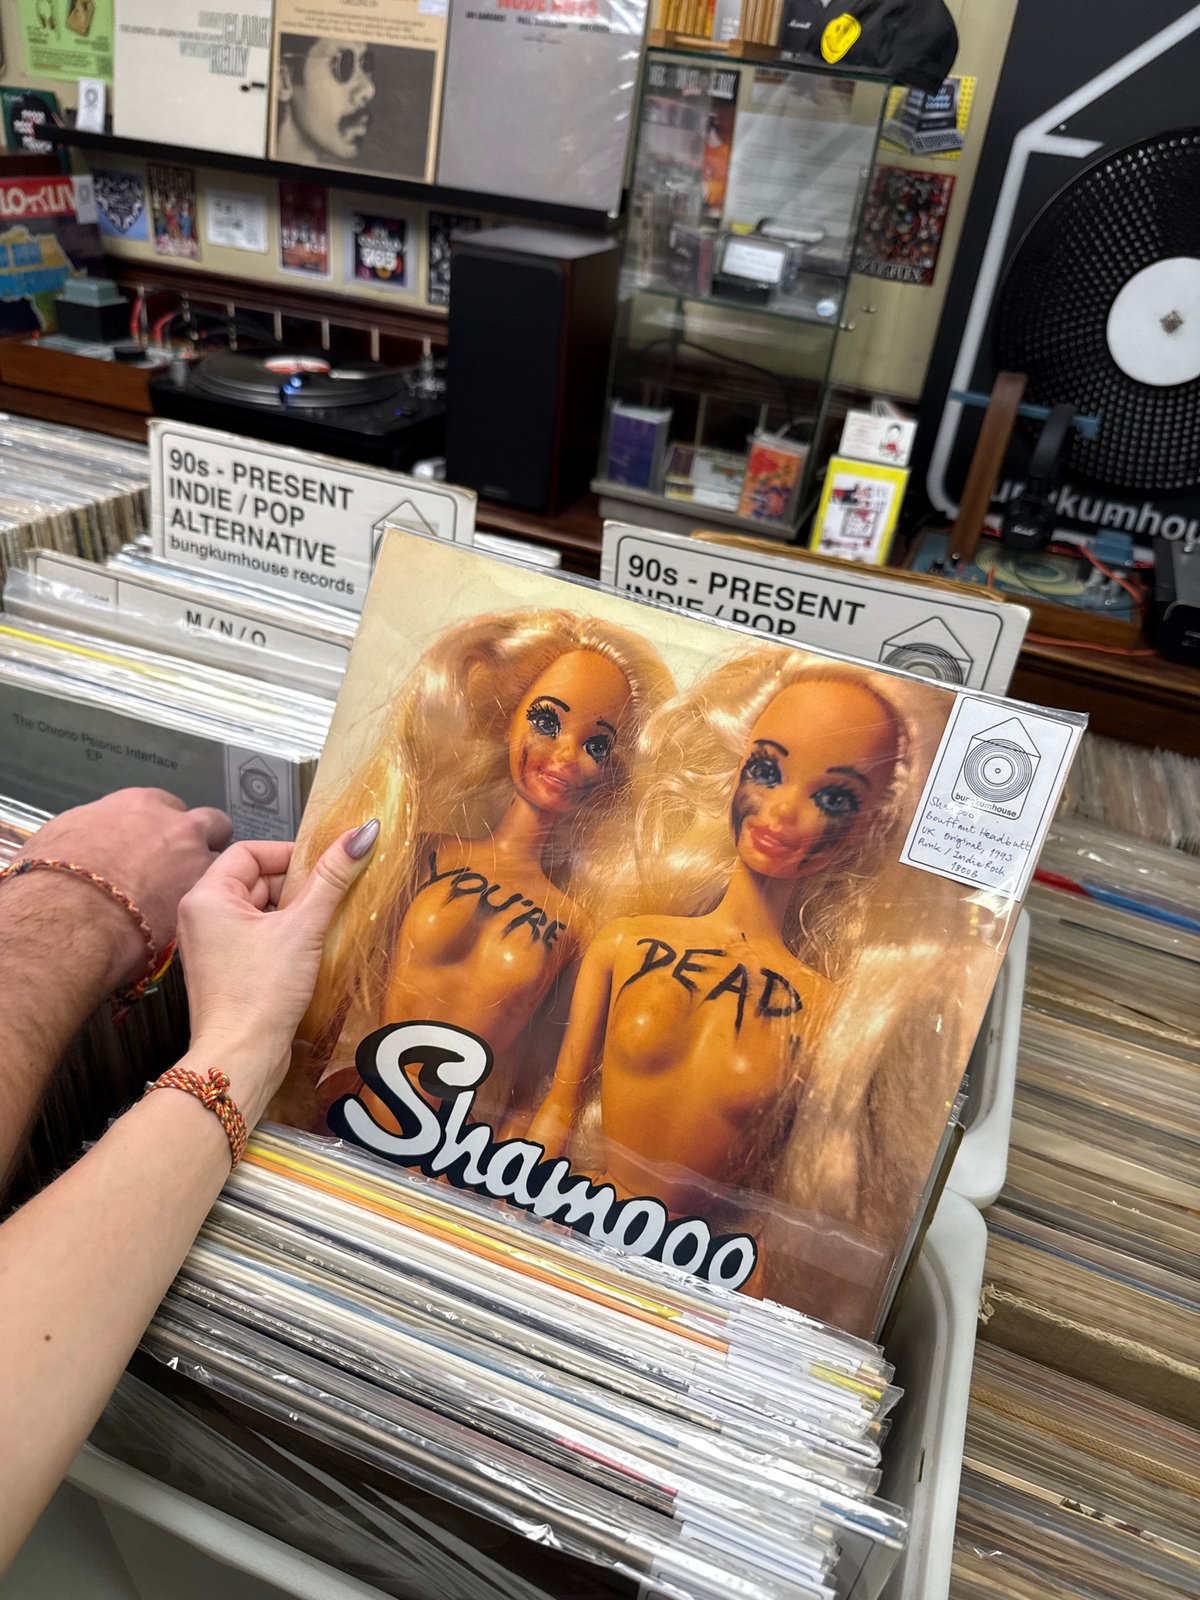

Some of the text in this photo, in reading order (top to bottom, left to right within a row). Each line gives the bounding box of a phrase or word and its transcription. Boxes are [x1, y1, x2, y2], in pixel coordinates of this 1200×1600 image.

[169, 449, 210, 477] 90s
[232, 462, 354, 511] PRESENT
[169, 477, 233, 511] INDIE
[254, 496, 306, 528] POP
[170, 507, 337, 568] ALTERNATIVE
[171, 535, 355, 595] bungkumhouse records
[628, 554, 678, 586] 90s
[708, 571, 866, 627] PRESENT
[186, 609, 202, 627] M
[219, 619, 234, 638] N
[13, 713, 179, 770] The Chrono Psionic Interface
[86, 749, 104, 762] EP
[917, 837, 942, 853] Punk
[952, 850, 983, 868] Indie
[984, 860, 1006, 877] Rock
[922, 826, 936, 838] UK
[990, 846, 1013, 862] 1993
[980, 827, 1032, 852] Headbutt
[617, 936, 803, 1034] DEAD
